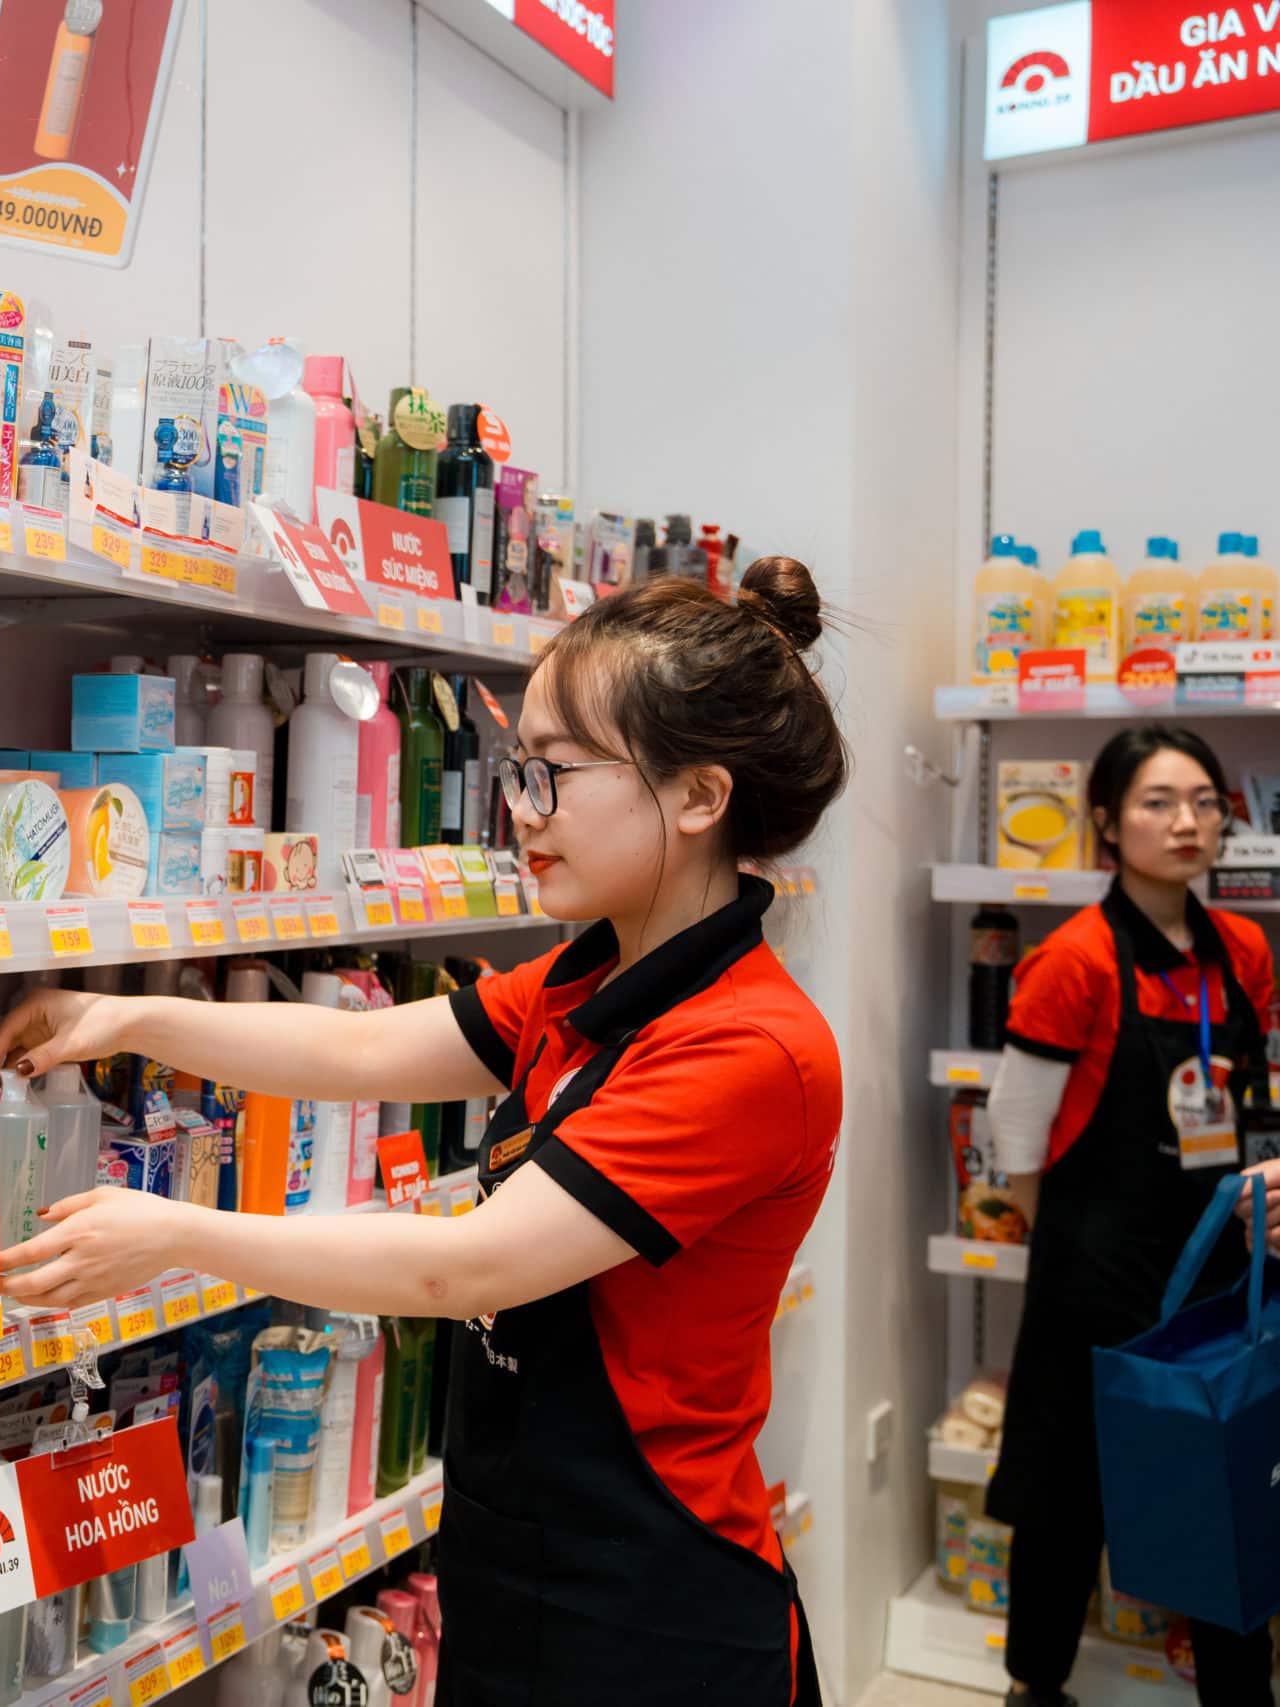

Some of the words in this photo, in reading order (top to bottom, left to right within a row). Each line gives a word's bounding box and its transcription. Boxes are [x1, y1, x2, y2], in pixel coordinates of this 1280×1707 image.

[1180, 8, 1245, 47] GIA
[1253, 1, 1280, 31] V
[1110, 60, 1186, 103] DẦU
[1192, 49, 1247, 88] ĂN
[1258, 46, 1280, 76] N
[34, 533, 55, 550] 239
[60, 928, 81, 947] 159
[172, 1298, 190, 1317] 249
[128, 1312, 147, 1333] 259
[43, 1338, 64, 1358] 139
[77, 1461, 131, 1504] NƯỚC
[65, 1519, 108, 1552] HOA
[109, 1496, 160, 1538] HỒNG
[138, 1673, 158, 1697] 309
